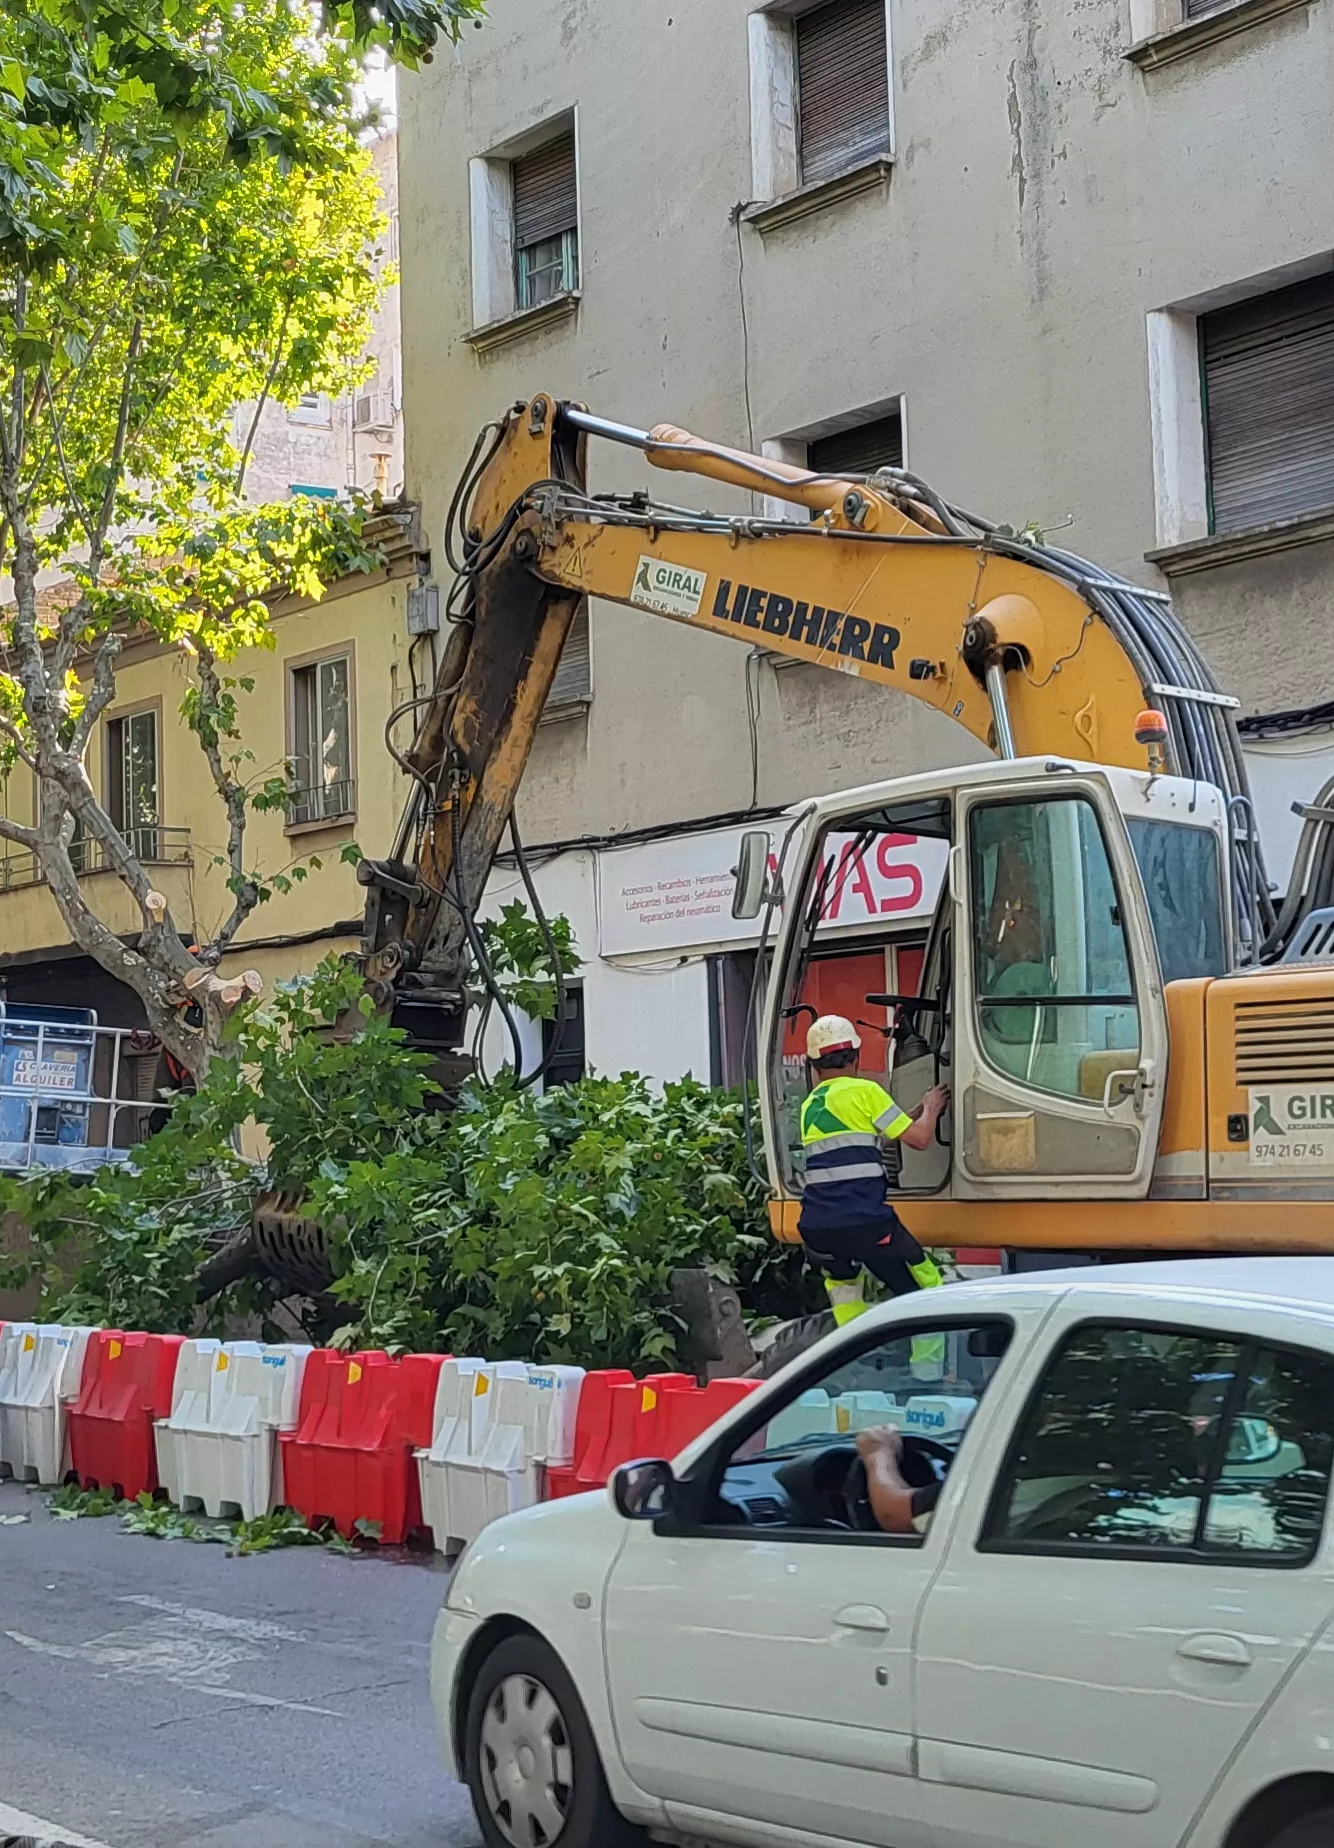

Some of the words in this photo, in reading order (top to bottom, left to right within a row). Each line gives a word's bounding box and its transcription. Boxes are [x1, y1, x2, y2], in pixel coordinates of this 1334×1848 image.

[656, 568, 700, 595] GIRAL
[712, 578, 901, 670] LIEBHERR
[622, 885, 653, 897] Accesorios
[657, 878, 691, 891] Recambios
[626, 897, 661, 910] Lubricantes
[665, 892, 690, 905] Baterías
[640, 910, 674, 924] Reparación
[675, 907, 685, 918] del
[686, 903, 720, 917] neumático
[30, 1062, 77, 1073] CAVERIA
[1255, 1144, 1276, 1158] 974
[1278, 1144, 1291, 1157] 21
[1293, 1143, 1308, 1157] 67
[1309, 1143, 1323, 1157] 45
